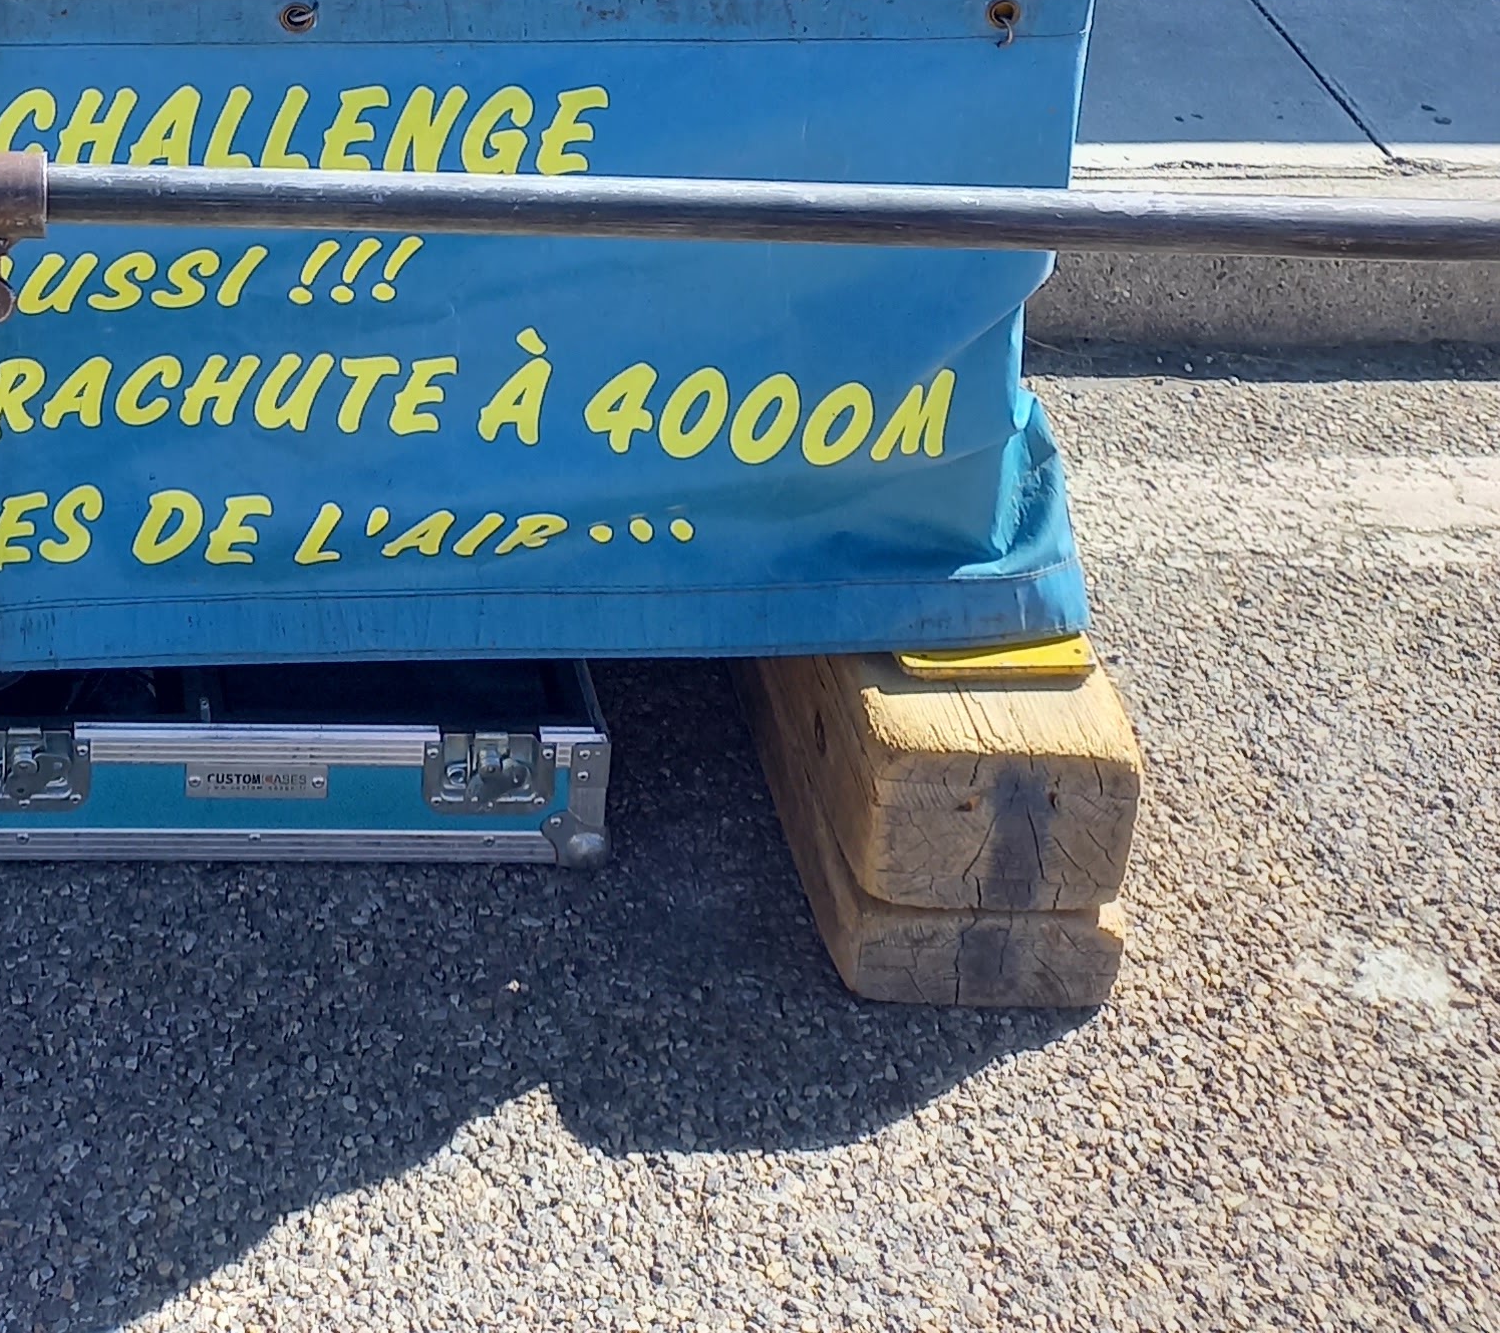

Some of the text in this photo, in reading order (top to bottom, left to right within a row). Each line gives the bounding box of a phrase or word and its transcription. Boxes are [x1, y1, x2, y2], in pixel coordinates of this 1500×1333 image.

[477, 326, 553, 447] À
[585, 360, 957, 467] 4000M
[132, 488, 273, 567] DE
